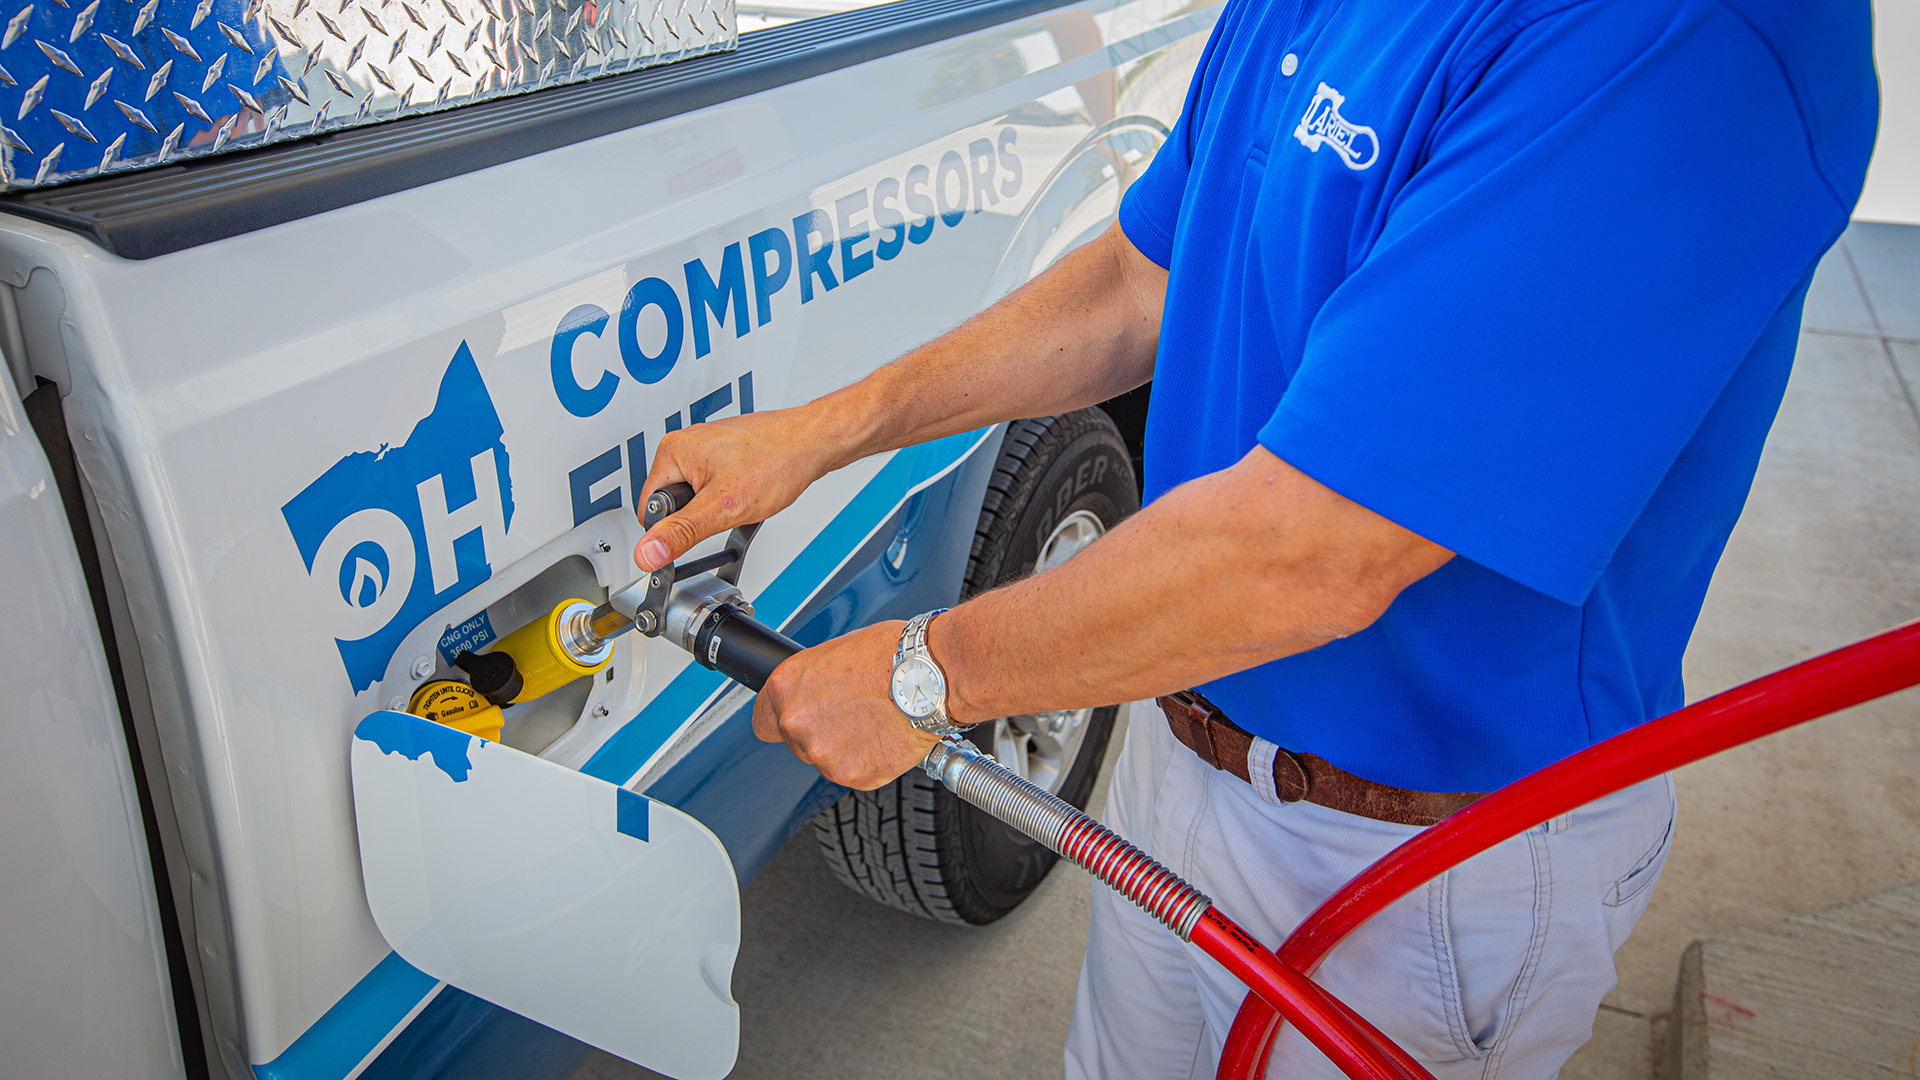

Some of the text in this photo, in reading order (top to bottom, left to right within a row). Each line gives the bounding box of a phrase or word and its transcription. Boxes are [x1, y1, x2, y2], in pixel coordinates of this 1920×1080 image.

[1308, 105, 1362, 160] ARIEL
[550, 127, 1023, 418] COMPRESSORS
[440, 614, 485, 647] CNG ONLY
[450, 629, 489, 659] 3600 PSI
[423, 685, 476, 711] TIGHTEN UNTIL CLICKS
[441, 706, 465, 718] Gasoline
